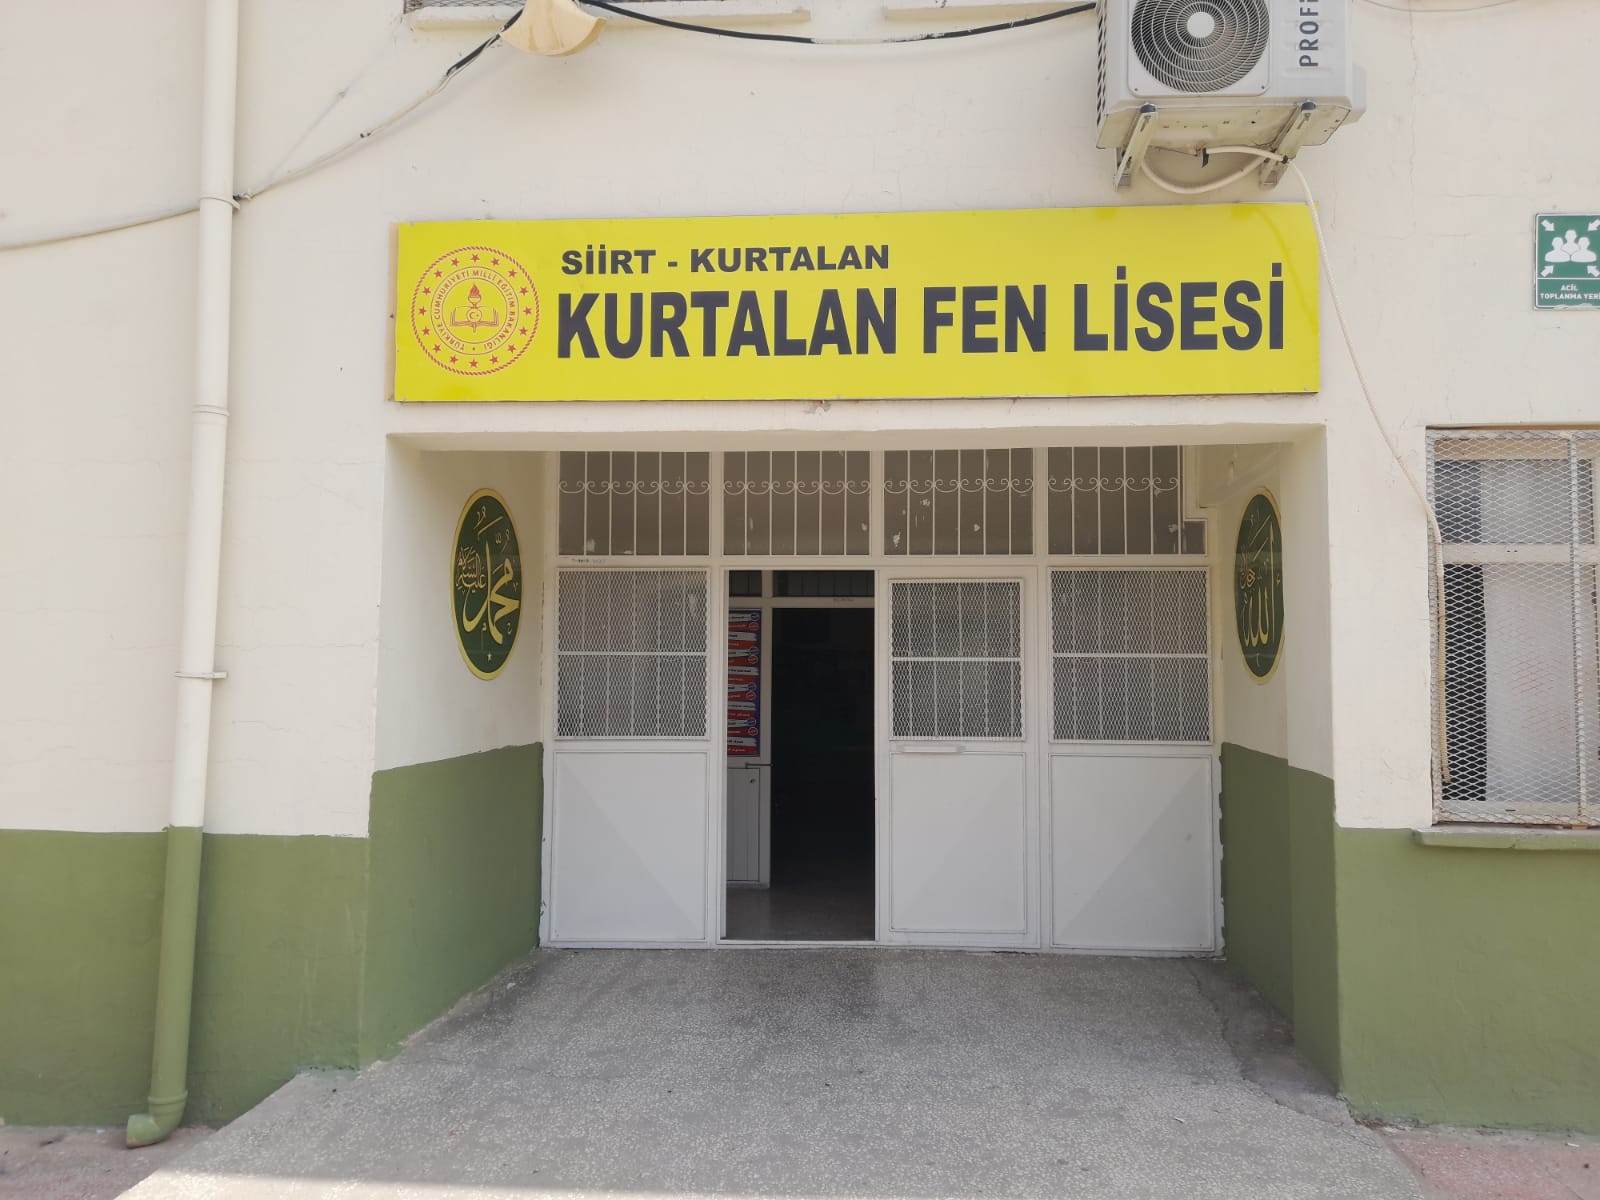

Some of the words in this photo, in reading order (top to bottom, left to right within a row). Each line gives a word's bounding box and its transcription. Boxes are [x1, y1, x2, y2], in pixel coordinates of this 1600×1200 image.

[562, 244, 657, 275] SİİRT
[690, 244, 889, 273] KURTALAN
[1560, 283, 1579, 291] ACİL
[557, 287, 897, 359] KURTALAN
[923, 284, 1047, 354] FEN
[1073, 262, 1284, 352] LİSESİ
